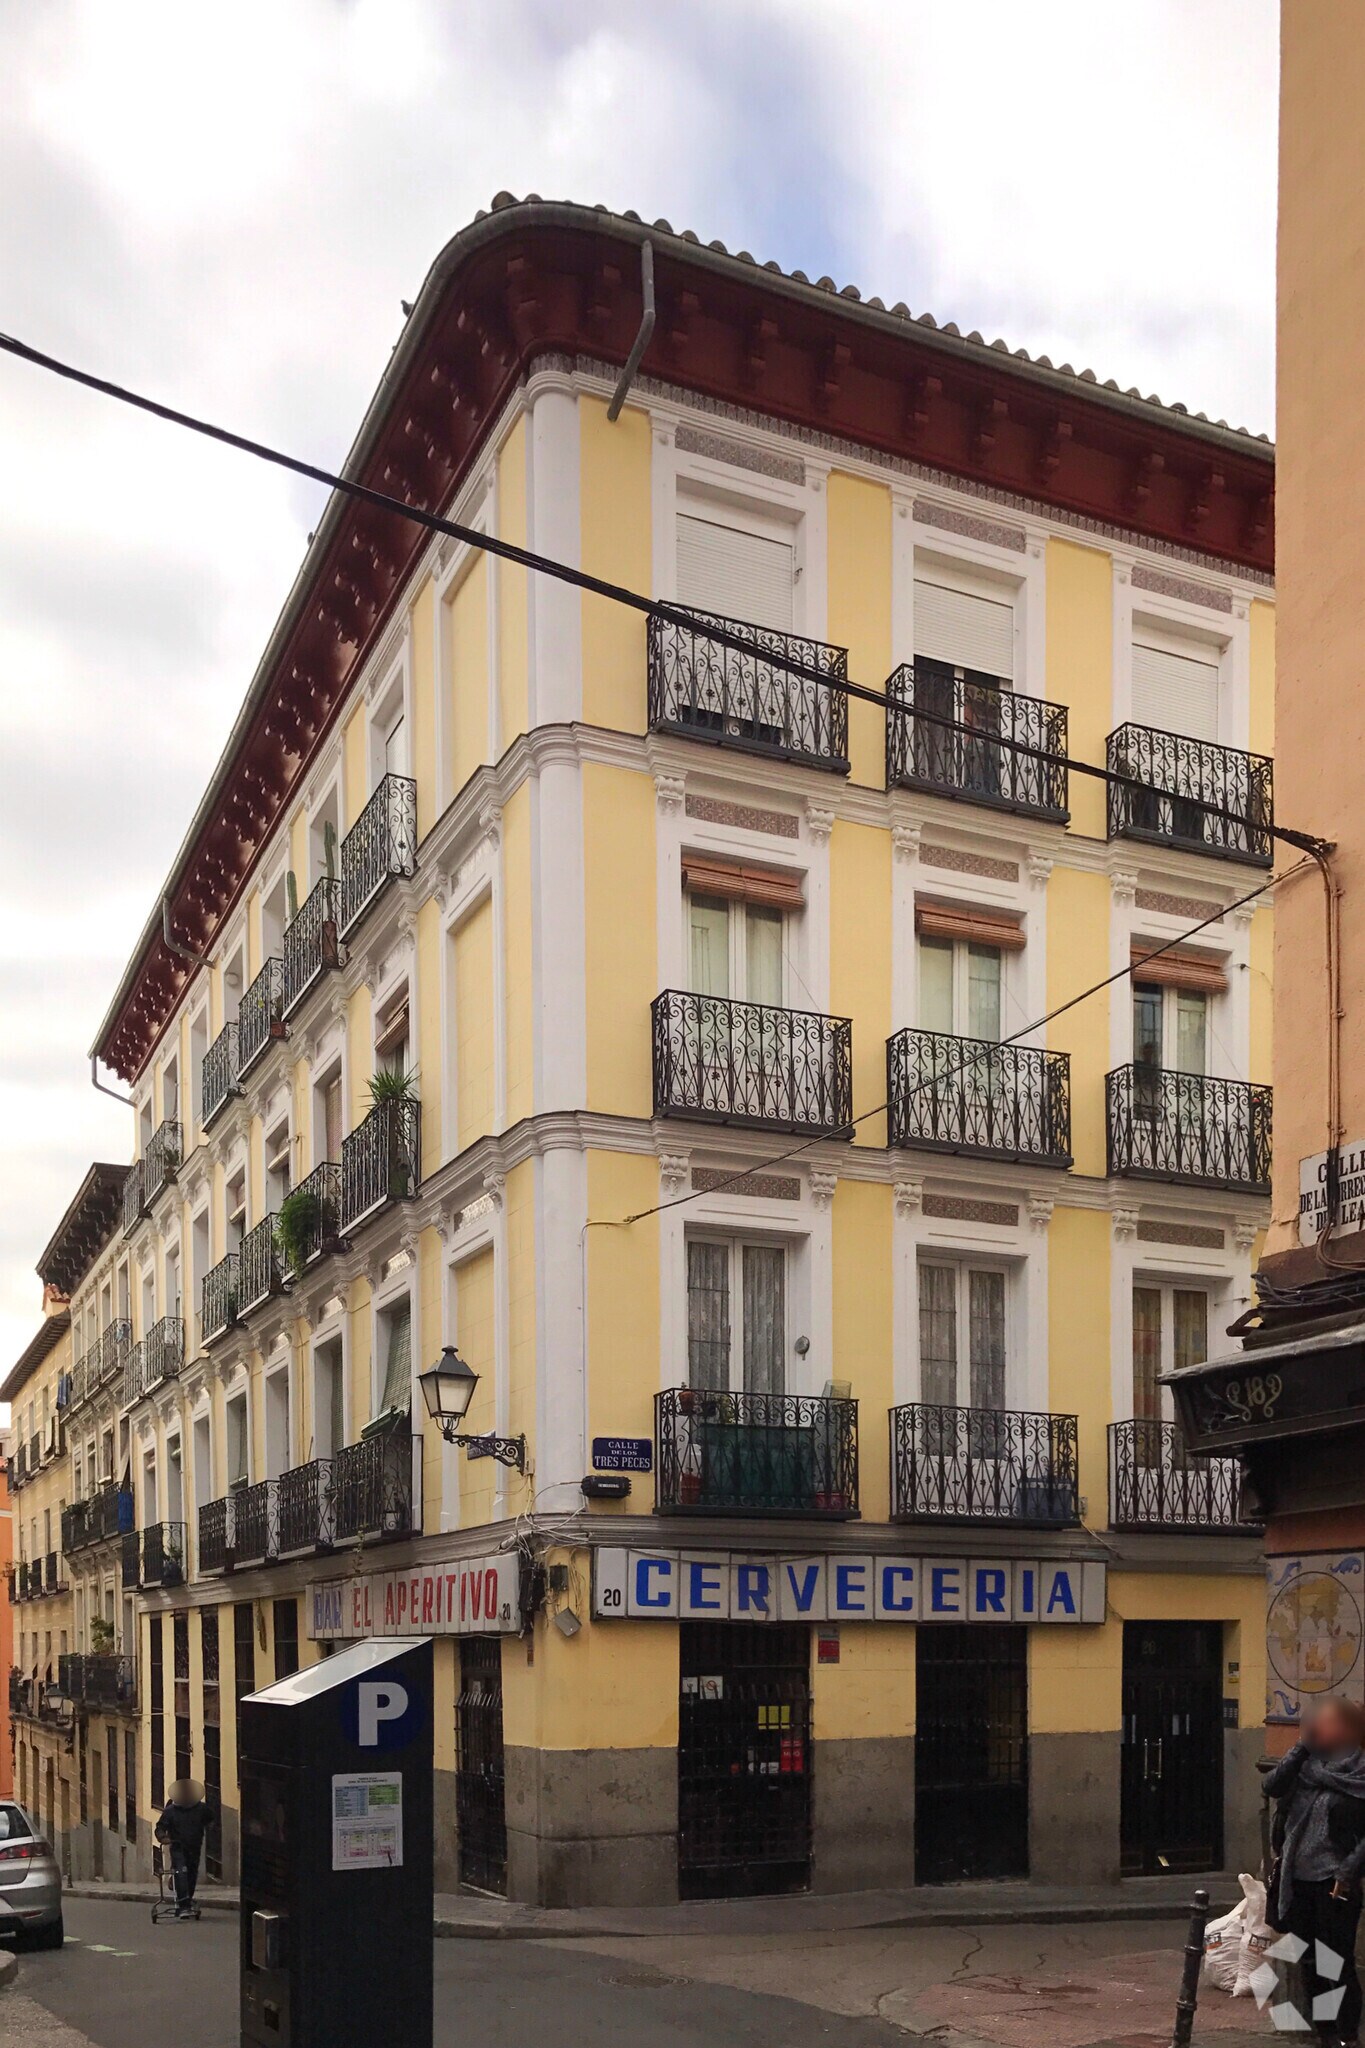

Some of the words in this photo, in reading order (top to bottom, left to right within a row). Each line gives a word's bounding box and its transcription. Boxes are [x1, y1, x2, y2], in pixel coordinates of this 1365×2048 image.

[1318, 1150, 1365, 1183] CLLE
[1300, 1192, 1313, 1214] DE
[1314, 1187, 1328, 1210] LA
[608, 1441, 639, 1449] CALLE
[594, 1455, 619, 1467] TRES
[621, 1456, 650, 1468] PECES
[314, 1590, 342, 1630] BAR
[353, 1585, 372, 1628] EL
[385, 1568, 498, 1626] APERITIVO
[603, 1588, 621, 1607] 20
[636, 1559, 1076, 1614] CERVECERIA
[502, 1603, 511, 1621] 20
[358, 1682, 409, 1746] P
